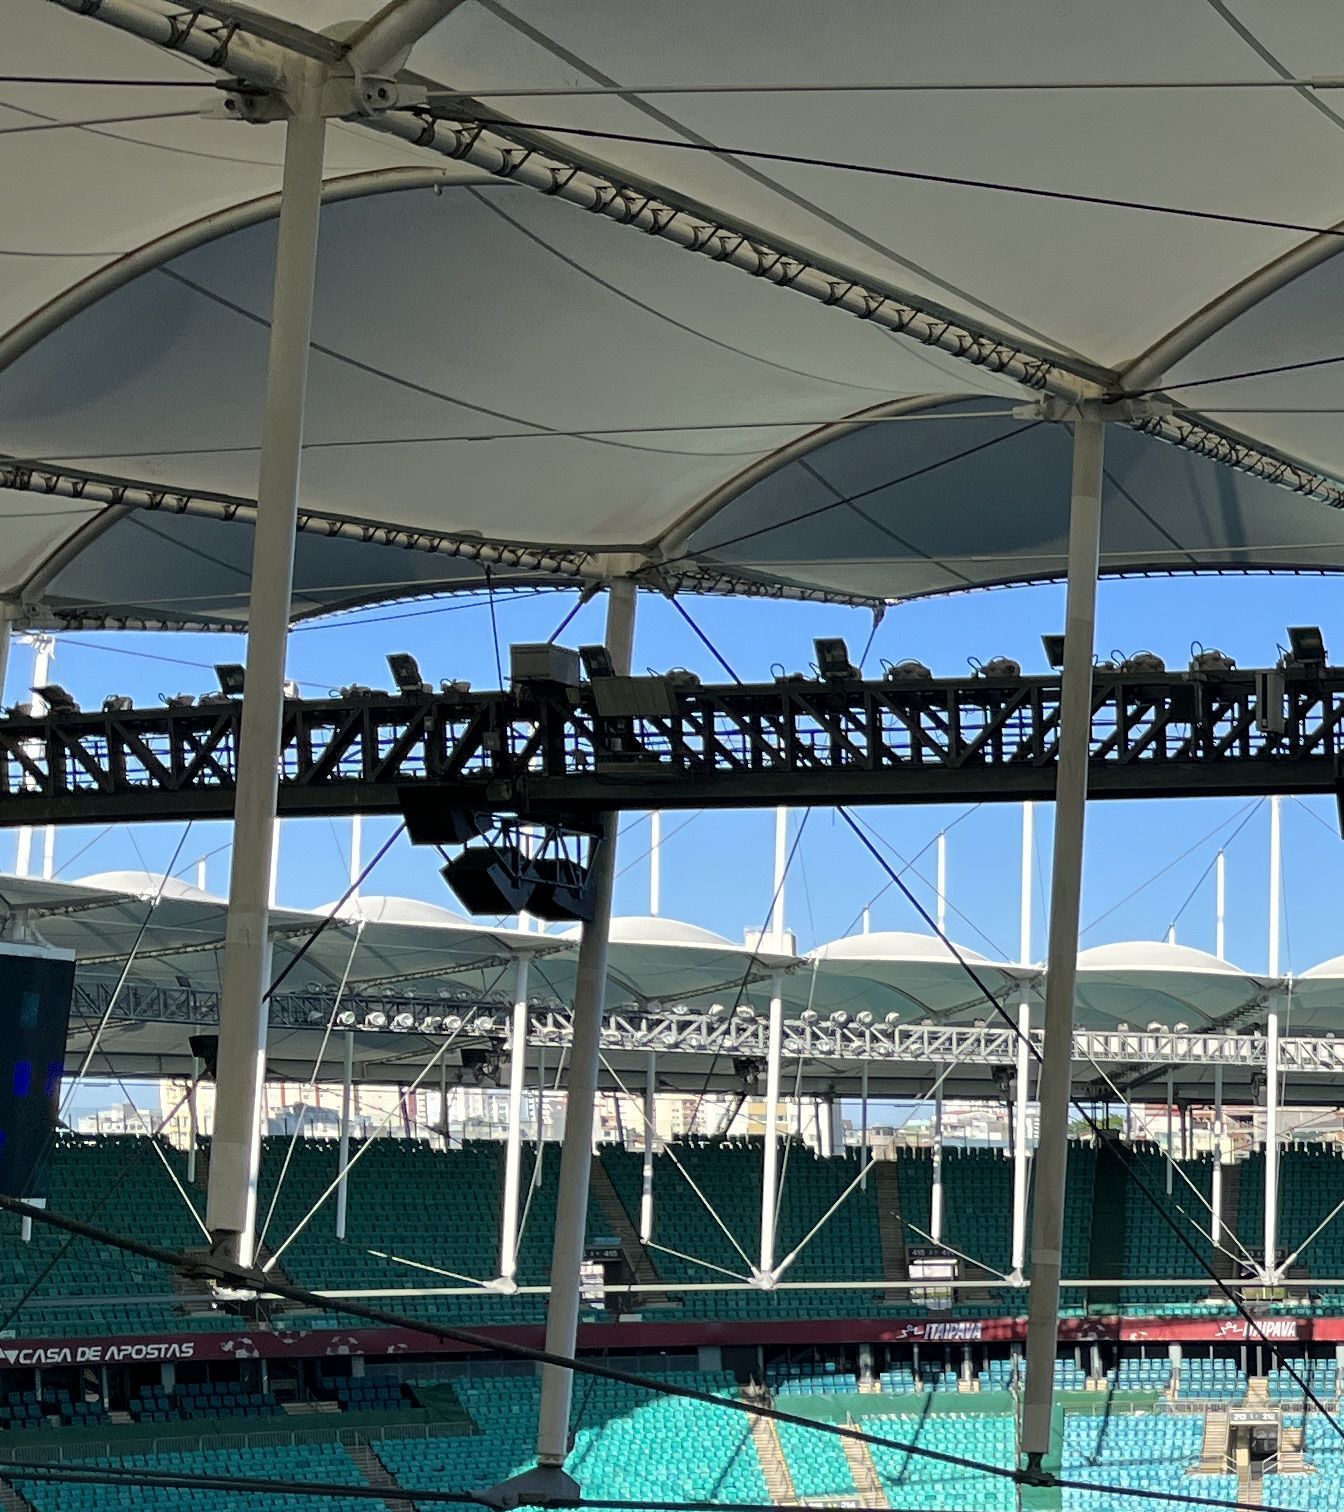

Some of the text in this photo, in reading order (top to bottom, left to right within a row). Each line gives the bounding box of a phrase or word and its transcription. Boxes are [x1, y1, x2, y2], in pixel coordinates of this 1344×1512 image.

[924, 1322, 982, 1340] ITAIPAVA
[19, 1342, 195, 1364] CASA DE APOSTAS
